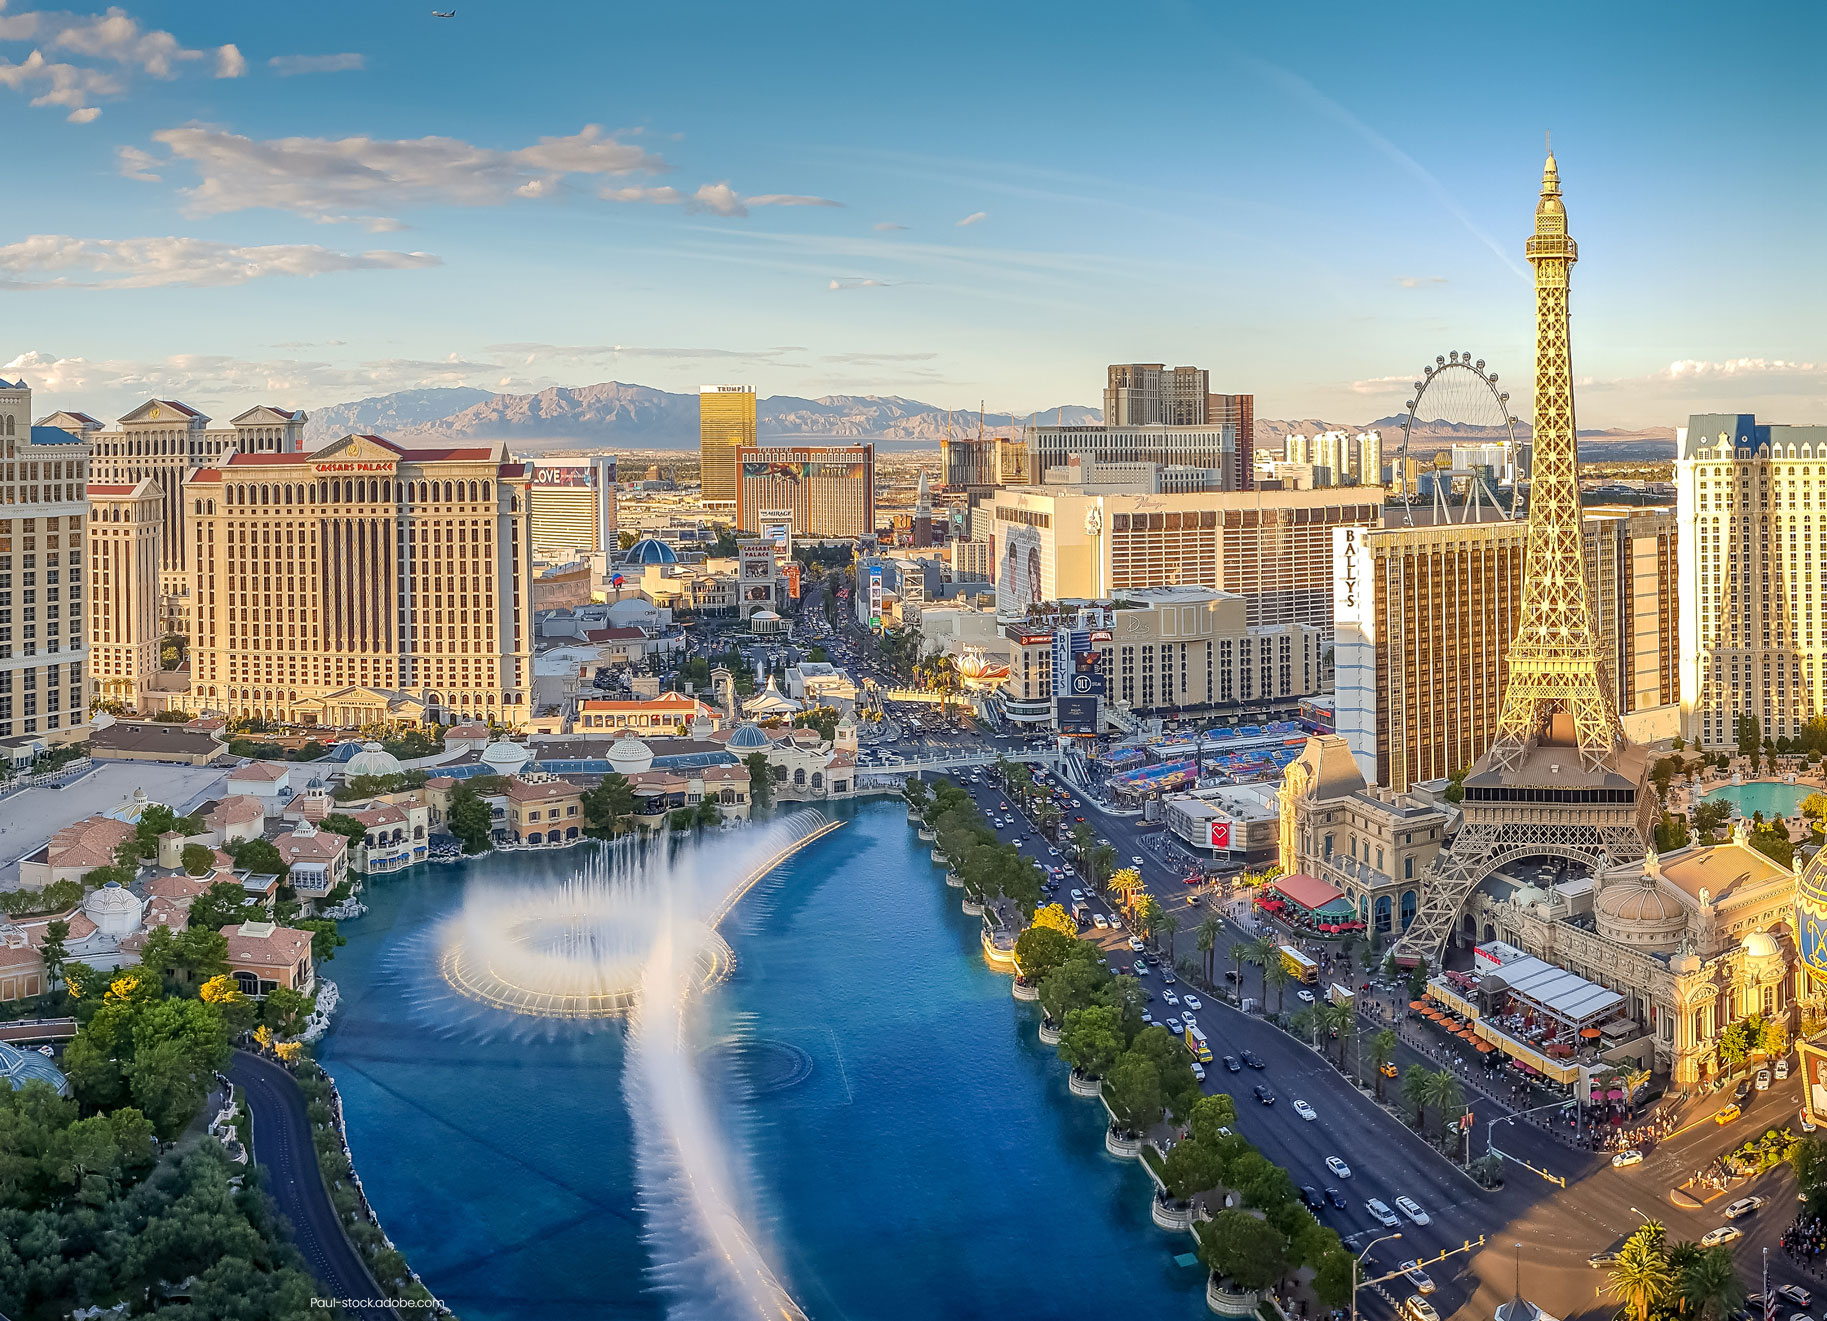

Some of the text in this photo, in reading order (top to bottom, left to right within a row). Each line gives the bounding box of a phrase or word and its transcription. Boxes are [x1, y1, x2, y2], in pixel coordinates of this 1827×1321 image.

[315, 463, 393, 472] CAESARS PALACE
[1077, 679, 1088, 689] BLT
